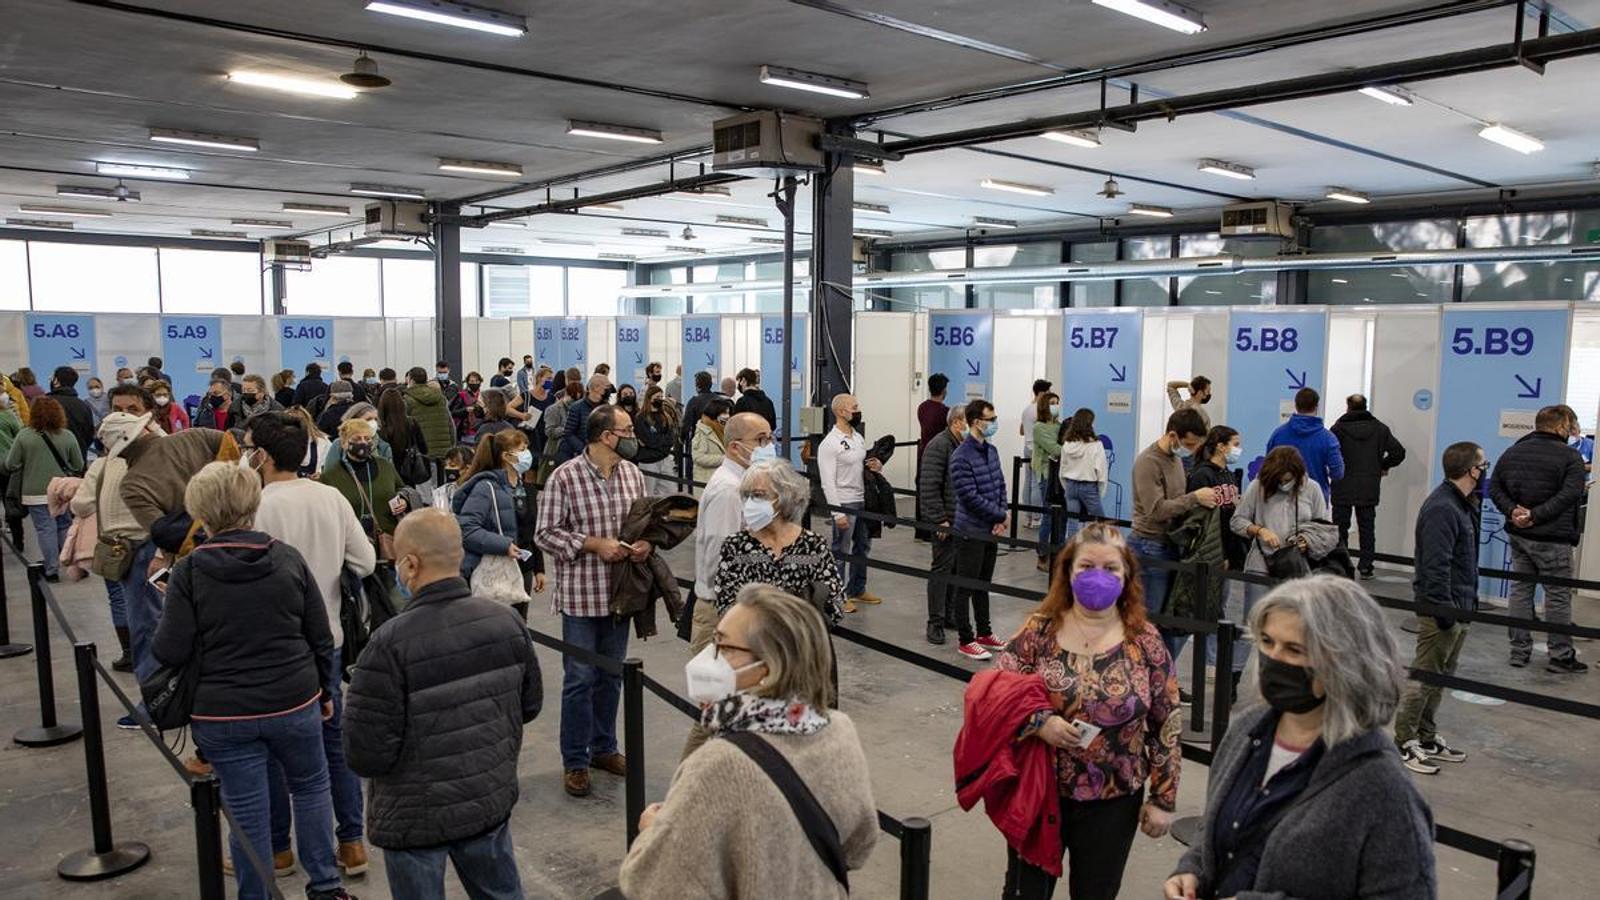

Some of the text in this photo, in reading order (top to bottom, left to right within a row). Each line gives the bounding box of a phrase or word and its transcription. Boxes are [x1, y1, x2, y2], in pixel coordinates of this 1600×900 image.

[34, 324, 79, 338] 5.A8
[168, 325, 206, 339] 5.A9
[284, 326, 325, 339] 5.A10
[537, 328, 552, 341] 5.B1
[561, 328, 579, 341] 5.B2
[618, 328, 639, 342] 5.B3
[685, 328, 710, 342] 5.B4
[765, 328, 784, 344] 5.B
[934, 326, 973, 346] 5.B6
[1071, 328, 1118, 348] 5.B7
[1236, 327, 1298, 352] 5.B8
[1452, 327, 1534, 355] 5.B9
